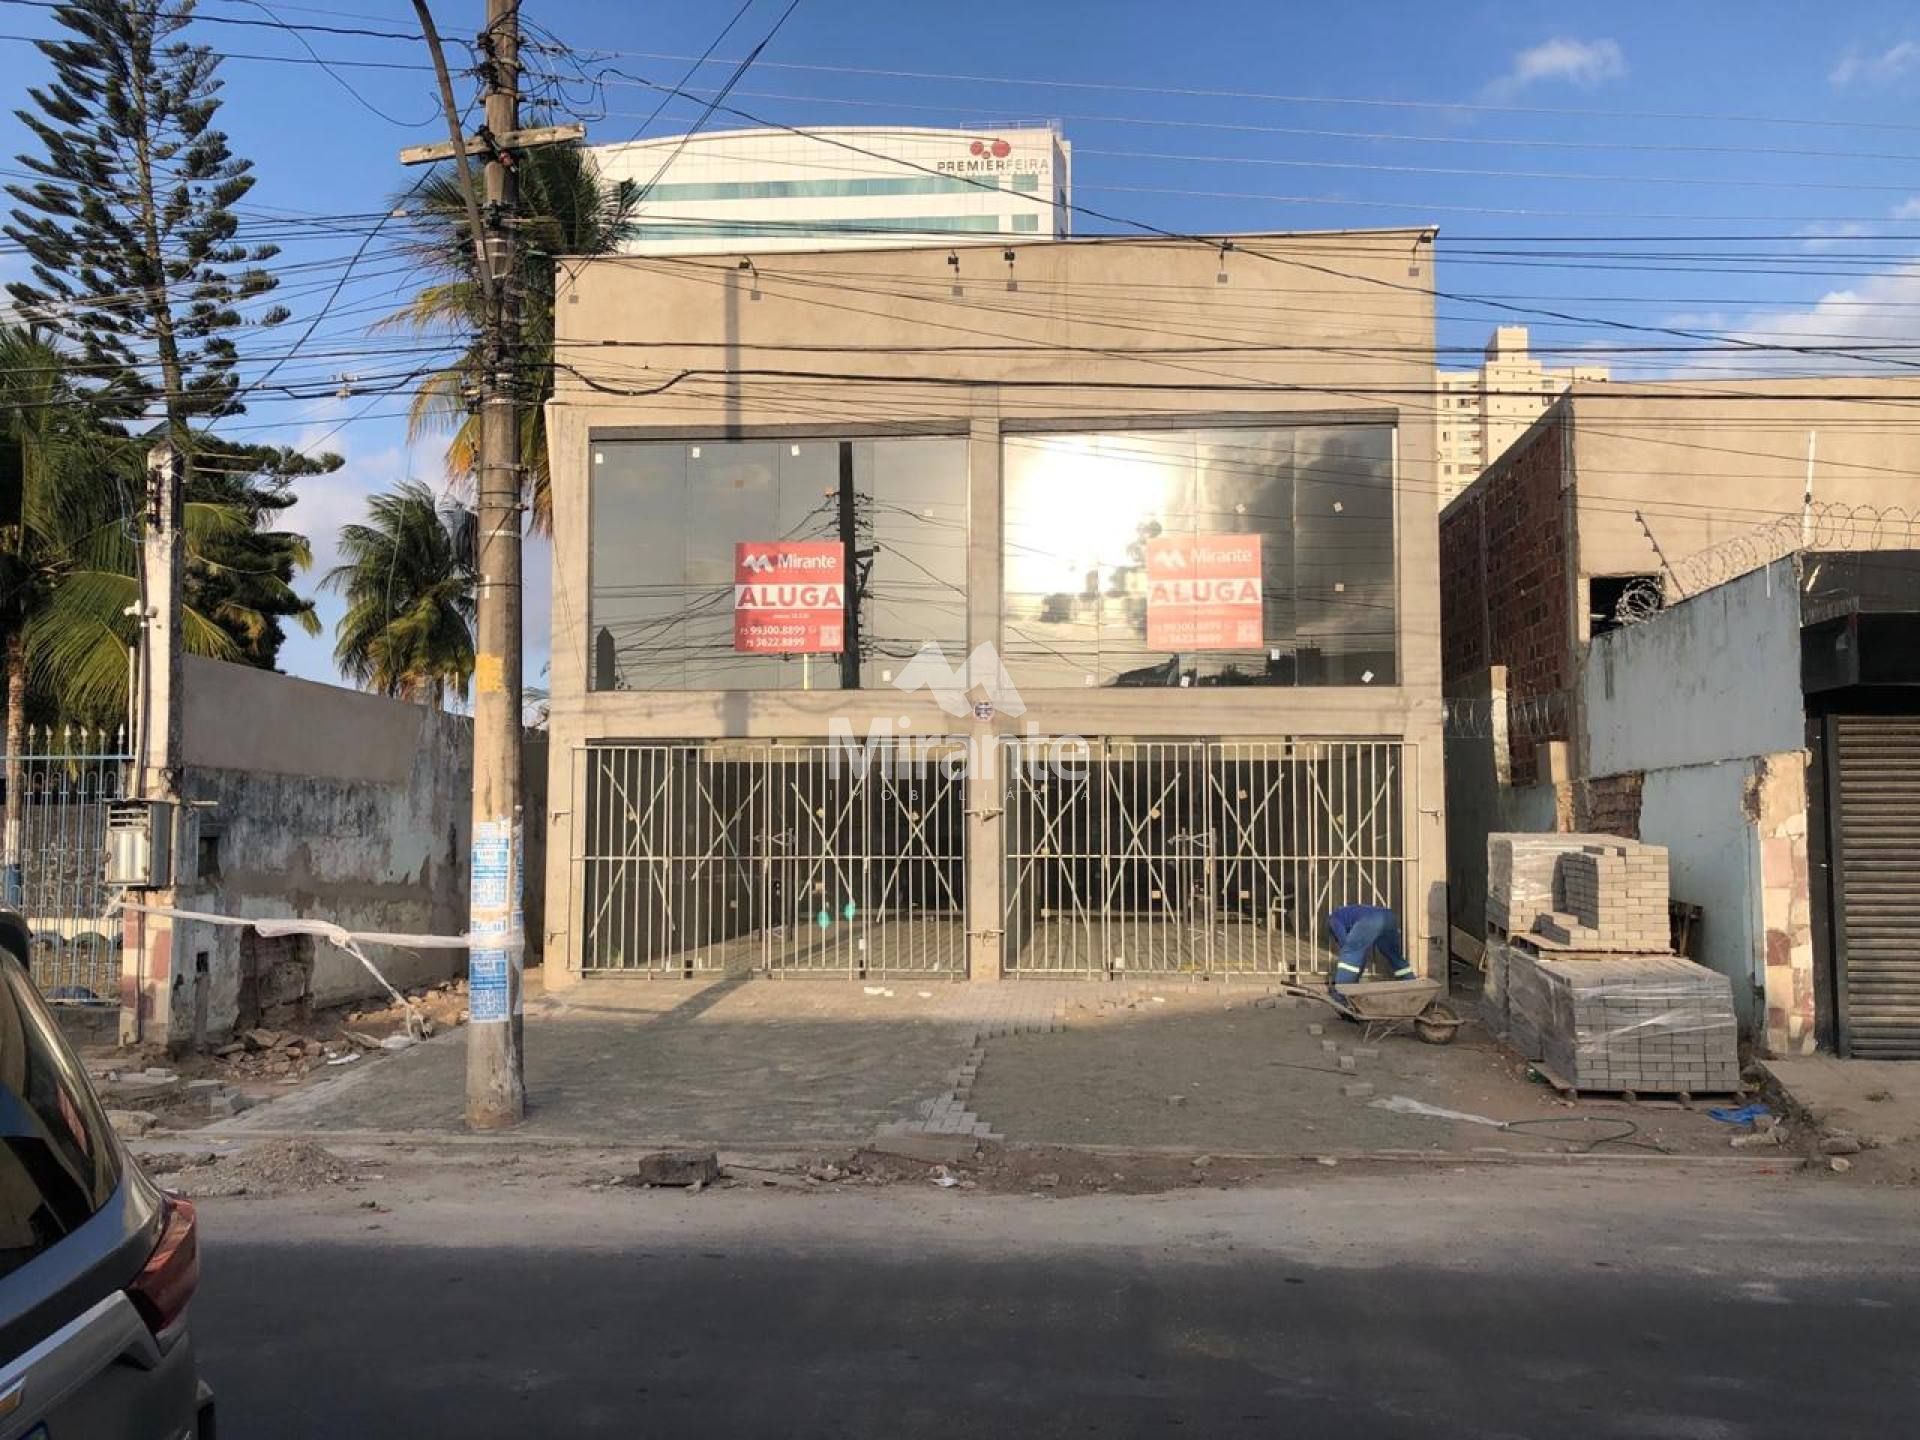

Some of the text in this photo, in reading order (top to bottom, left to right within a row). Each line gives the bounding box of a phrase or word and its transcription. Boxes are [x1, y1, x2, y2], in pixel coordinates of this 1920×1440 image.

[777, 553, 836, 569] Mirante
[737, 586, 841, 607] ALUGA
[1151, 581, 1259, 602] ALUGA
